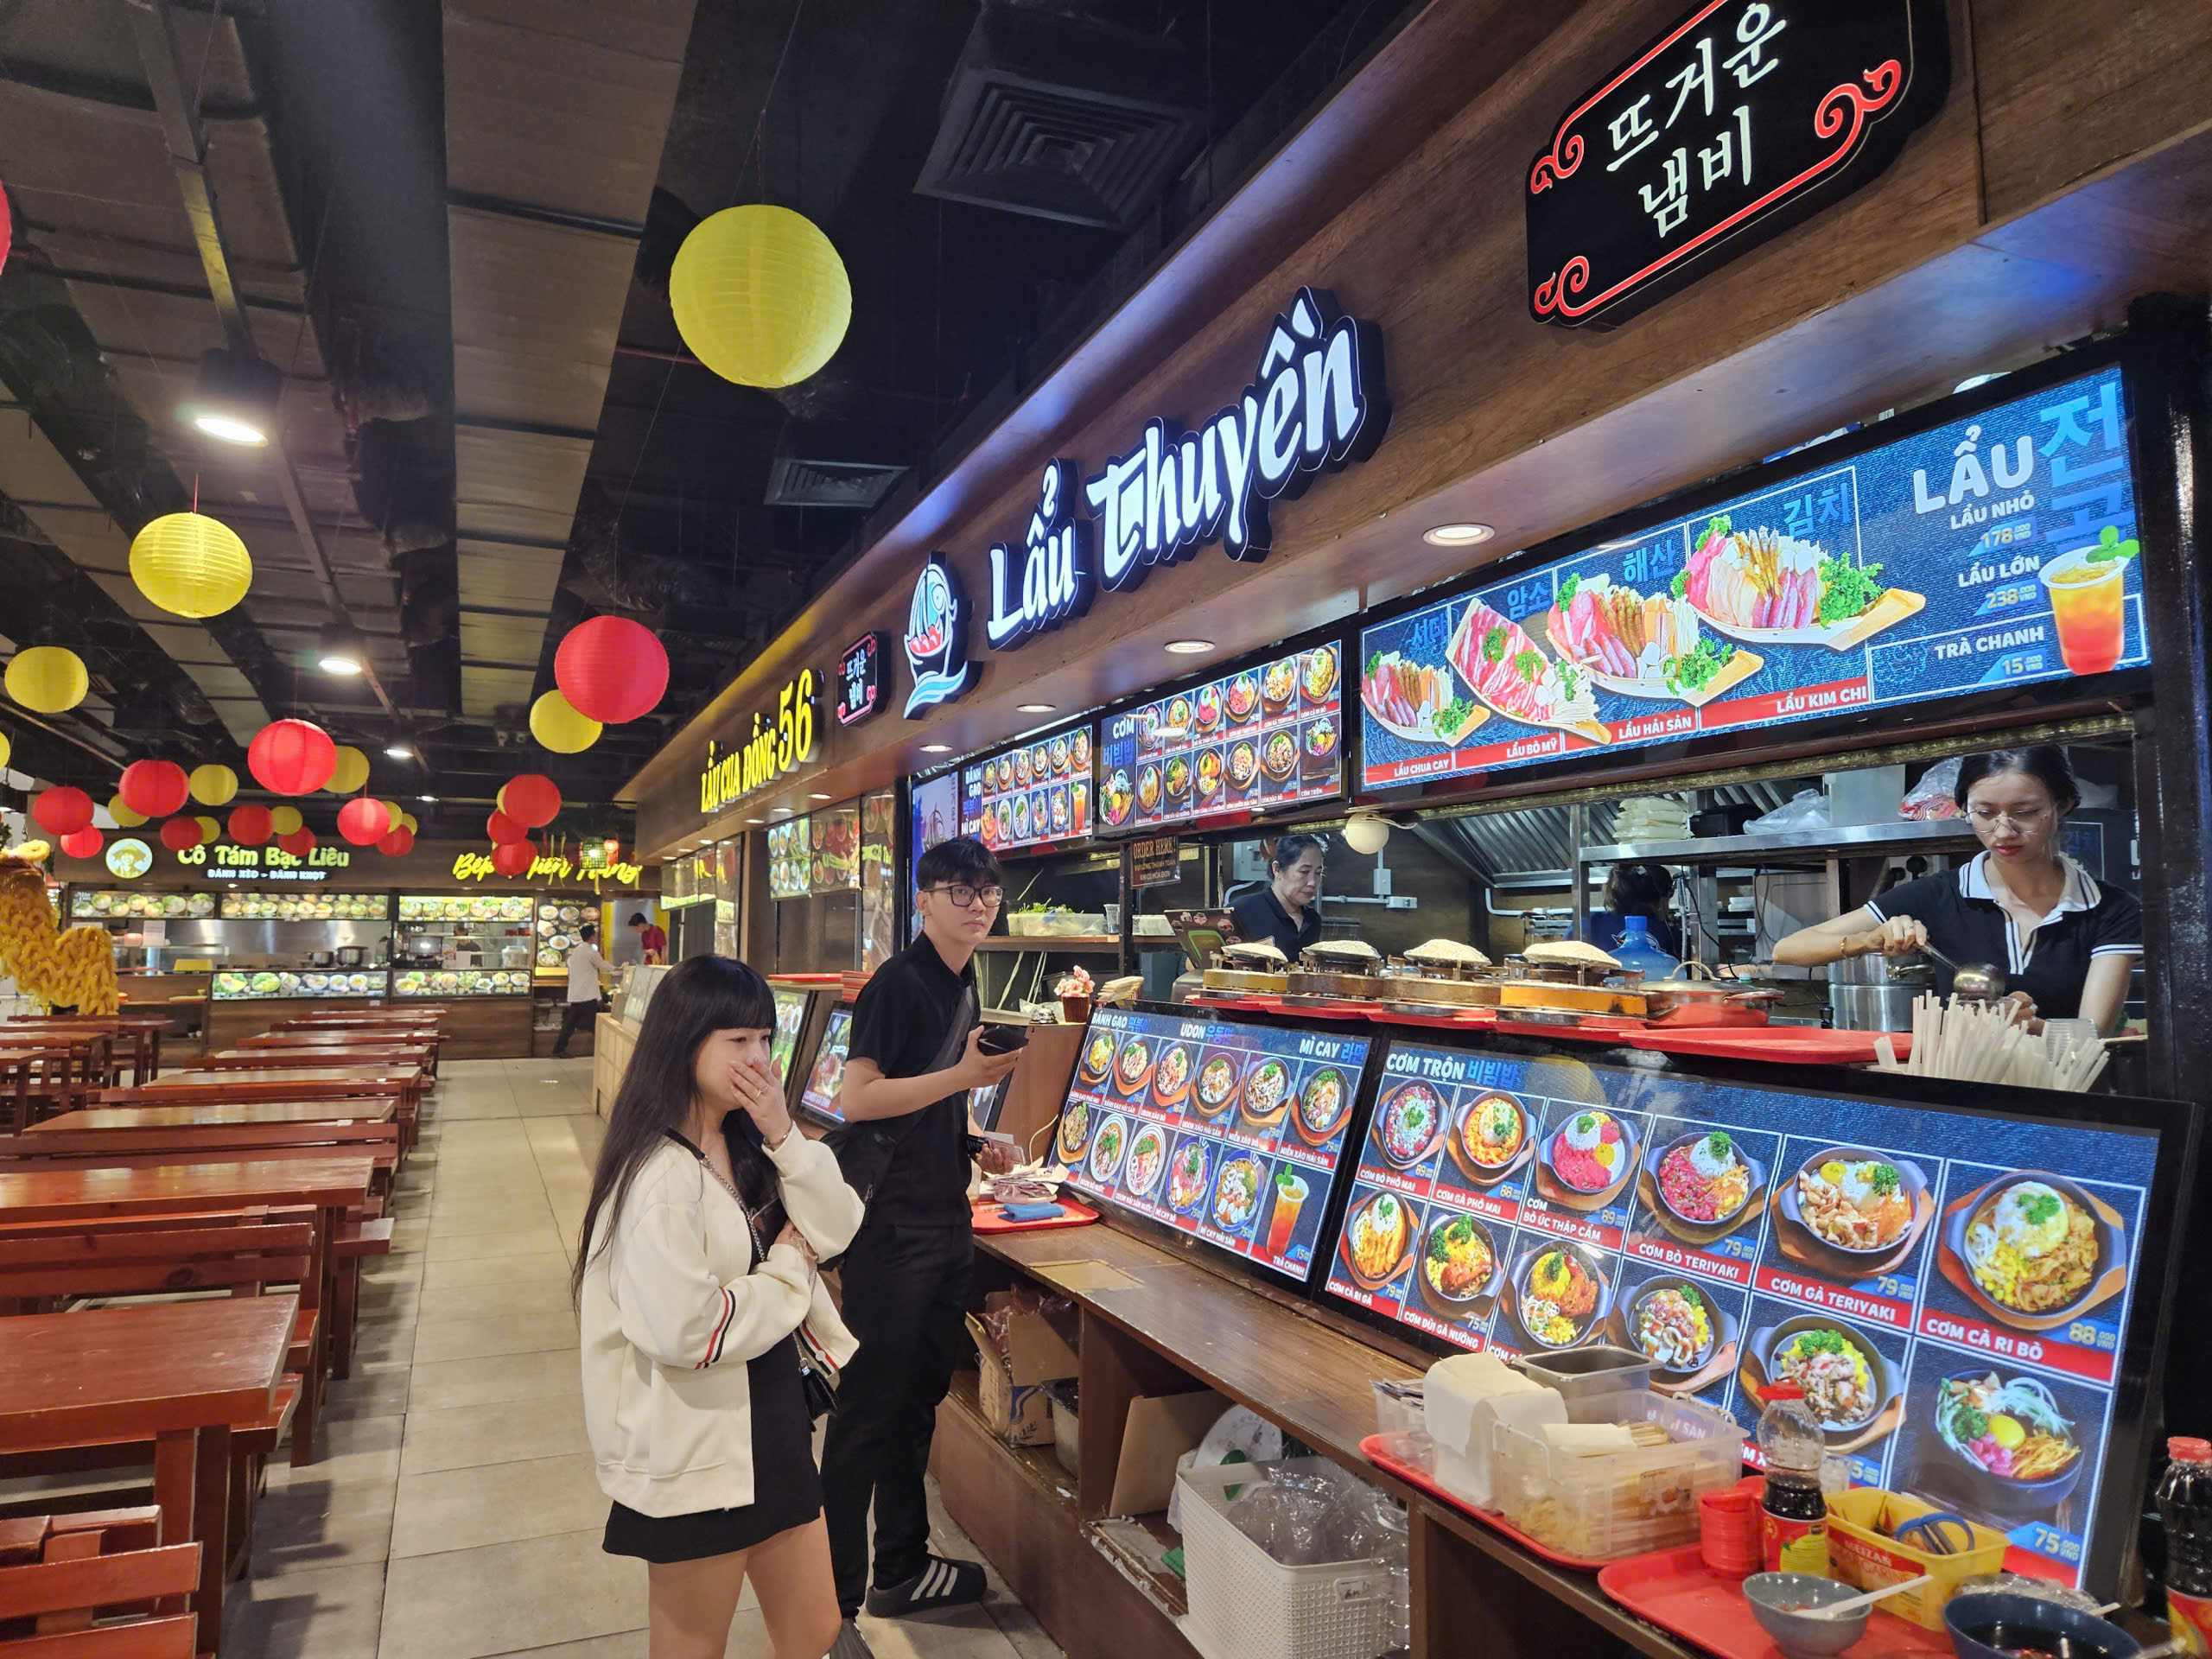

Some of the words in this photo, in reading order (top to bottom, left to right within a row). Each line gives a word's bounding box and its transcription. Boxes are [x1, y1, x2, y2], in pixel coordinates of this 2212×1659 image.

[1606, 3, 1787, 172] 뜨거운
[1638, 105, 1752, 238] 냄비
[1912, 424, 2034, 515] LẨU
[1783, 482, 1850, 537] 김치
[1950, 503, 1987, 530] LẨU
[1992, 493, 2035, 518] NHỎ
[1982, 527, 2013, 549] 178
[987, 464, 1076, 641] Lẩu
[1623, 539, 1675, 583] 해산
[1958, 562, 1994, 588] LẨU
[1999, 555, 2041, 577] LỚN
[1507, 581, 1551, 622] 암소
[1986, 588, 2018, 608] 238
[1935, 636, 1974, 659] TRÀ
[1976, 626, 2044, 652] CHANH
[2001, 658, 2024, 675] 15
[1777, 691, 1805, 714] LẨU
[1808, 692, 1837, 709] KIM
[1839, 685, 1867, 702] CHI
[721, 751, 741, 804] CUA
[779, 668, 813, 772] 56
[1112, 716, 1135, 740] CƠM
[1618, 721, 1642, 741] LẨU
[1643, 717, 1665, 735] HẢI
[1667, 711, 1692, 732] SẢN
[1103, 739, 1135, 768] 비빔밥
[1506, 739, 1525, 759] LẨU
[1526, 741, 1541, 755] BÒ
[1541, 735, 1559, 753] MỸ
[1394, 761, 1409, 778] LẨU
[1410, 763, 1432, 776] CHUA
[1433, 759, 1450, 772] CAY
[969, 818, 981, 835] CAY
[177, 844, 207, 865] Cô
[214, 844, 259, 866] Tám
[265, 846, 302, 869] Bạc
[308, 846, 350, 868] Liêu
[1133, 841, 1154, 860] ORDER
[1090, 1010, 1111, 1026] BÁNH
[1112, 1014, 1128, 1031] GẠO
[1179, 1022, 1206, 1039] UDON
[1300, 1035, 1314, 1055] MÌ
[1315, 1039, 1341, 1058] CAY
[1386, 1052, 1421, 1074] CƠM
[1422, 1056, 1466, 1082] TRỘN
[1467, 1059, 1519, 1090] 비빔밥
[1360, 1169, 1376, 1182] CƠM
[1376, 1171, 1385, 1184] BÒ
[1386, 1175, 1402, 1188] PHÔ
[1402, 1179, 1417, 1192] MAI
[1436, 1188, 1454, 1202] CƠM
[1454, 1192, 1466, 1205] GÀ
[1467, 1196, 1485, 1211] PHÔ
[1485, 1202, 1502, 1215] MAI
[1527, 1198, 1548, 1211] CƠM
[1523, 1210, 1537, 1224] BÒ
[1537, 1211, 1552, 1226] ÚC
[1552, 1219, 1577, 1236] THẬP
[1577, 1220, 1602, 1241] CẨM
[1601, 1209, 1616, 1224] 89
[1724, 1238, 1742, 1256] 79
[1273, 1255, 1285, 1268] TRÀ
[1285, 1261, 1306, 1277] CHANH
[1638, 1243, 1663, 1260] CƠM
[1665, 1249, 1682, 1264] BÒ
[1684, 1255, 1740, 1280] TERIYAKI
[1329, 1280, 1344, 1294] CƠM
[1344, 1285, 1355, 1298] CÀ
[1355, 1290, 1362, 1300] RI
[1362, 1293, 1373, 1306] GÀ
[1385, 1284, 1396, 1298] 79
[1877, 1274, 1898, 1296] 79
[1771, 1277, 1803, 1297] CƠM
[1804, 1285, 1824, 1301] GÀ
[1828, 1292, 1897, 1322] TERIYAKI
[1404, 1311, 1421, 1325] CƠM
[1421, 1316, 1435, 1332] ĐÙI
[1436, 1321, 1449, 1338] GÀ
[1449, 1326, 1479, 1350] NƯỚNG
[1467, 1317, 1479, 1331] 75
[2069, 1322, 2097, 1345] 88
[1489, 1344, 1510, 1362] CƠM
[1926, 1319, 1965, 1341] CƠM
[1967, 1328, 1991, 1347] CÀ
[1994, 1336, 2013, 1353] RI
[2017, 1341, 2044, 1361] BÒ
[2035, 1527, 2061, 1554] 75
